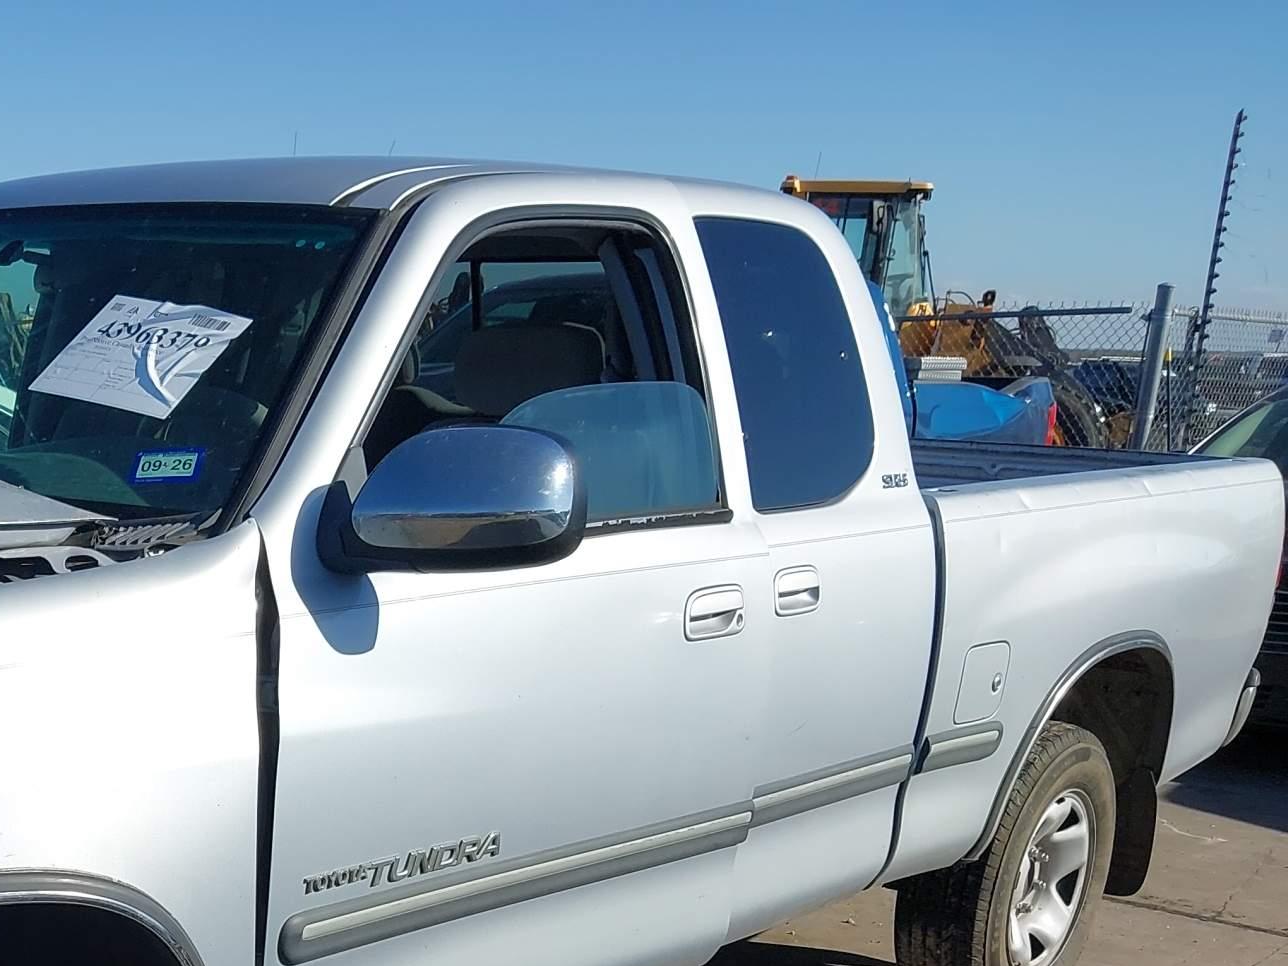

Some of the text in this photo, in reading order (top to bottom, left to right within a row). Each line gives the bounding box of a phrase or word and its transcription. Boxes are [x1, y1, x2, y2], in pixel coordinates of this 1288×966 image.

[141, 458, 193, 472] 09 26
[303, 831, 501, 895] TOYOTA TUNDRA
